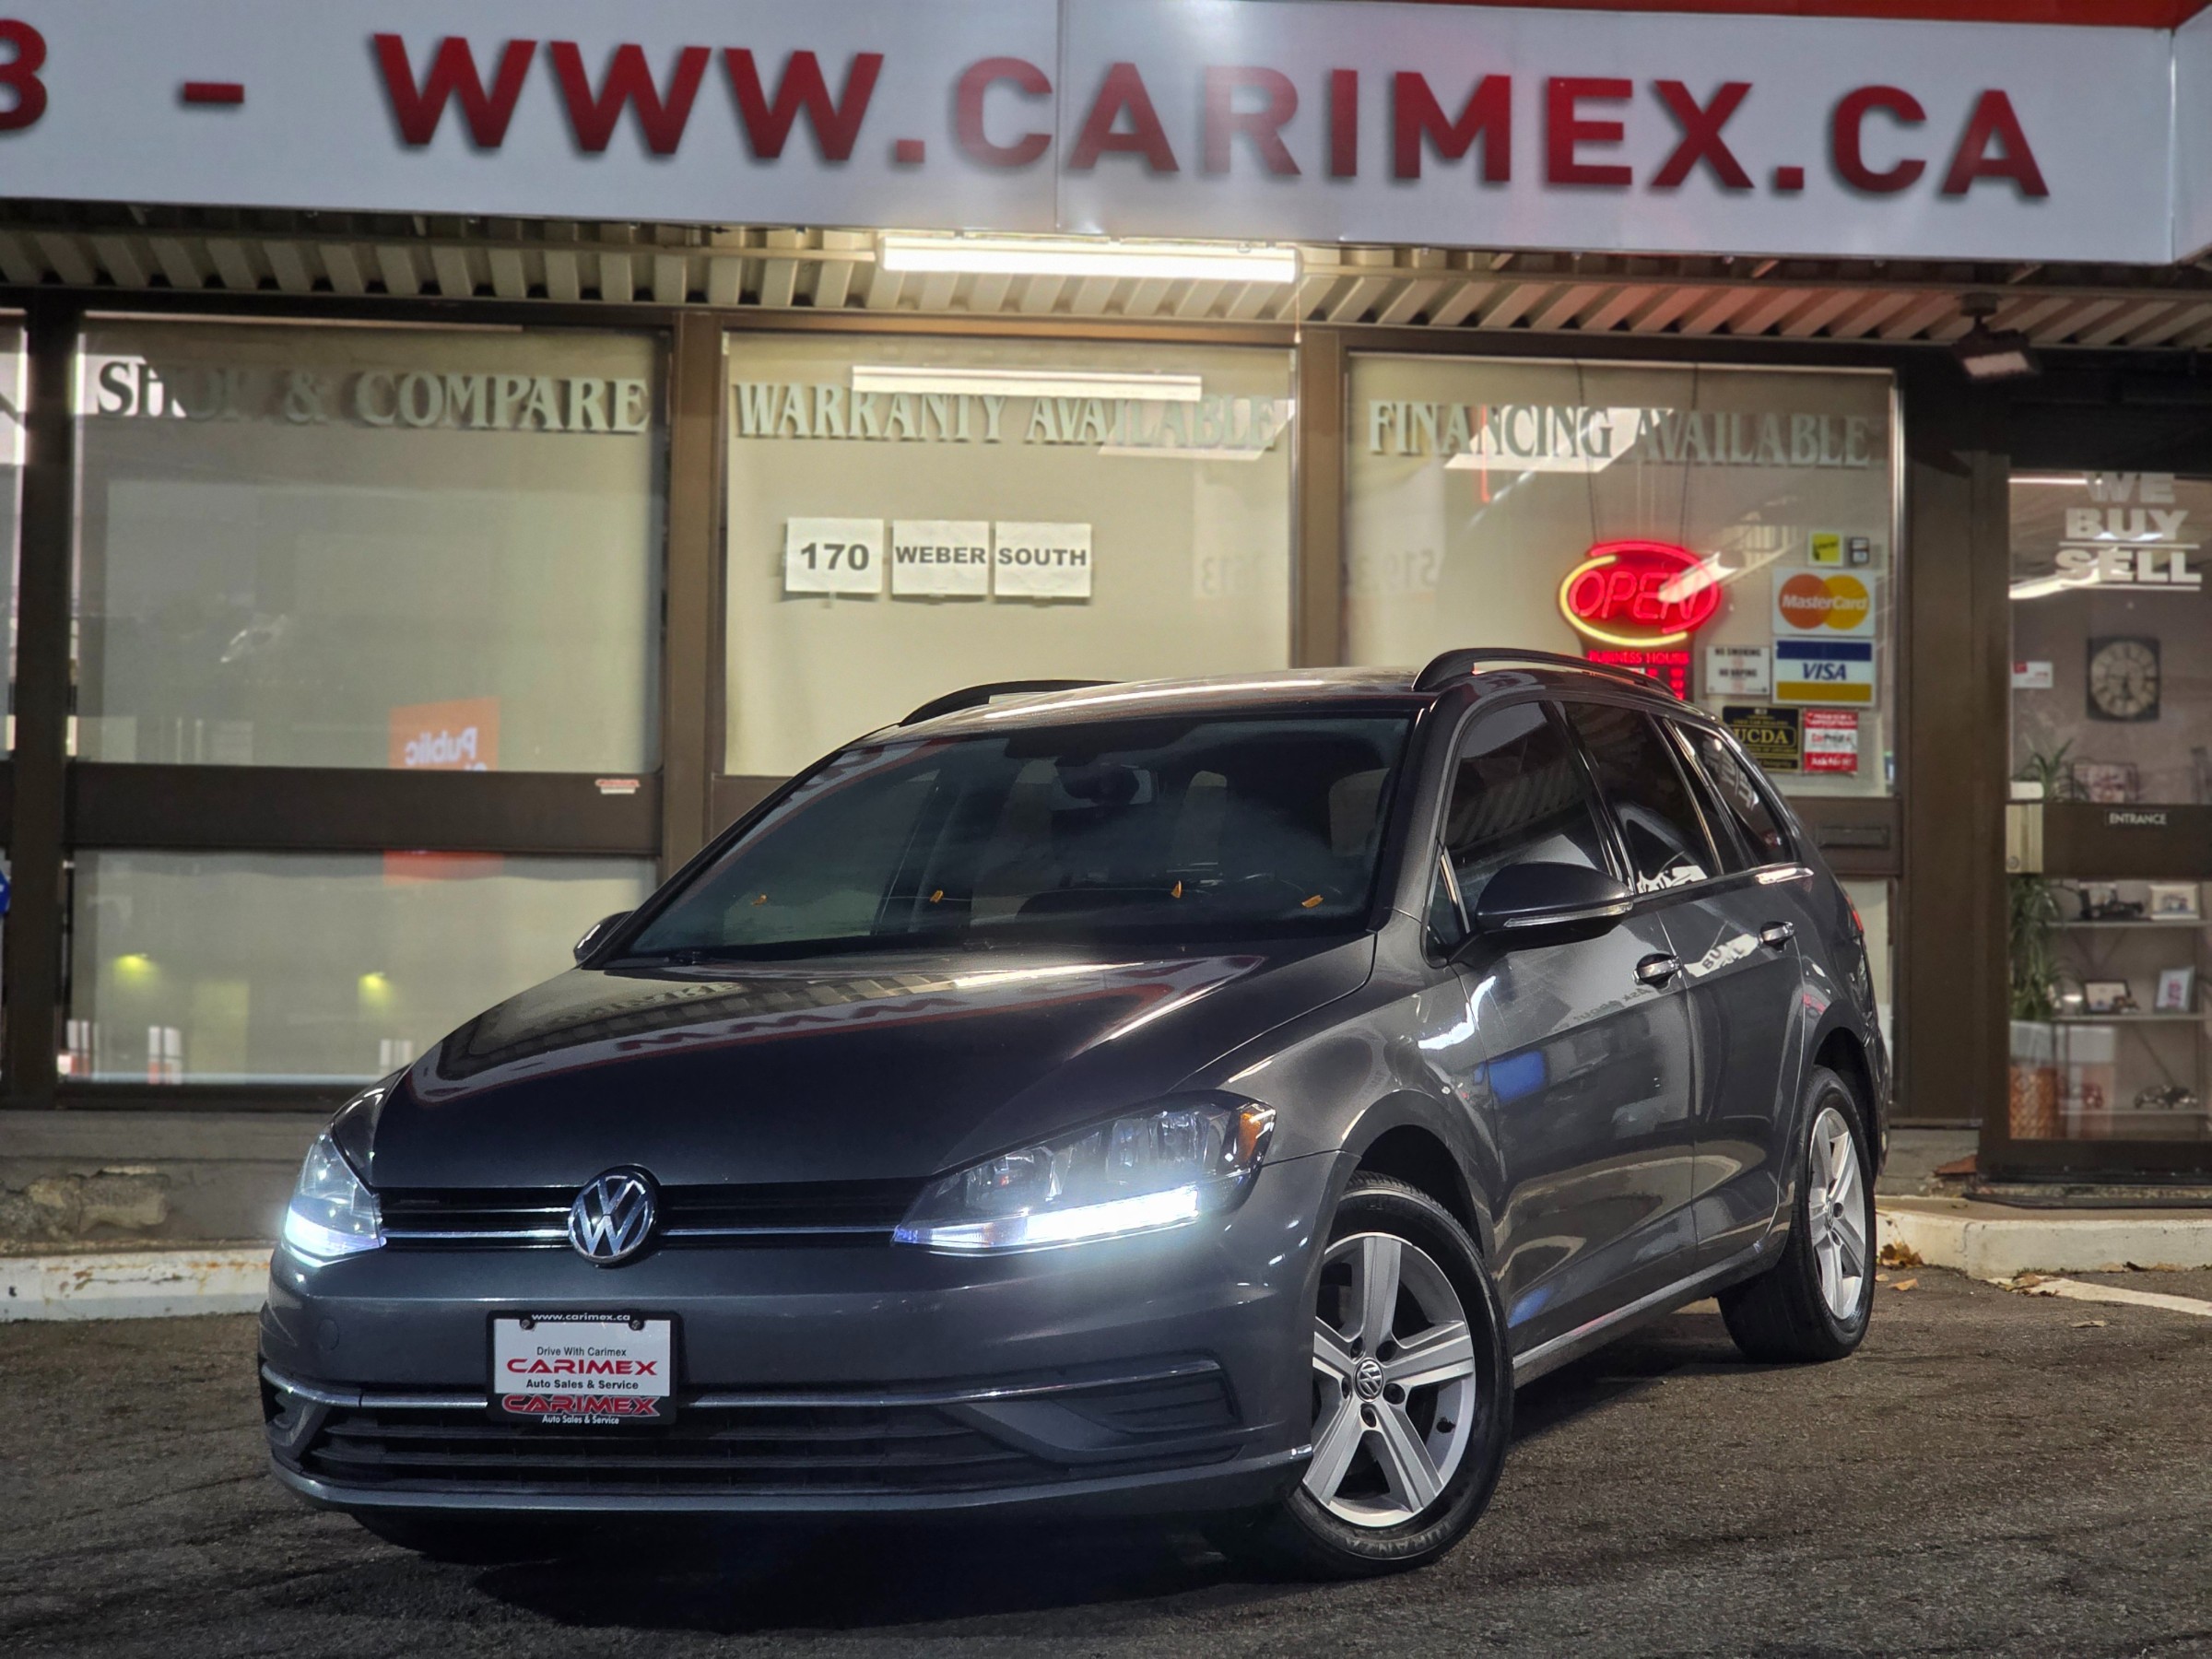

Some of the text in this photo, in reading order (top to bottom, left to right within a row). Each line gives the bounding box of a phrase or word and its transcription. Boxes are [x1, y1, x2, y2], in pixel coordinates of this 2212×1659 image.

[373, 32, 2051, 198] WWW.CARIMEX.CA
[355, 370, 650, 433] COMPARE
[735, 382, 1277, 450] WARRANTY AVAILABLE
[1369, 400, 1871, 466] FINANCING AVAILABLE
[2083, 471, 2176, 503] WE
[2065, 508, 2189, 540] BUY
[800, 542, 1087, 571] 170 WEBER SOUTH
[2055, 547, 2202, 583] SELL
[1569, 570, 1700, 620] OPEN
[1782, 594, 1867, 610] MasterCard
[1801, 662, 1847, 681] VISA
[1733, 728, 1789, 745] UCDA
[2109, 812, 2167, 825] ENTRANCE
[531, 1312, 630, 1321] www.carimex.ca
[536, 1347, 627, 1357] Drive With Carimex
[507, 1358, 658, 1376] CARIMEX
[526, 1379, 639, 1390] Auto Sales & Service
[504, 1394, 659, 1416] CARIMEX
[542, 1415, 619, 1425] Auto Sales & Service
